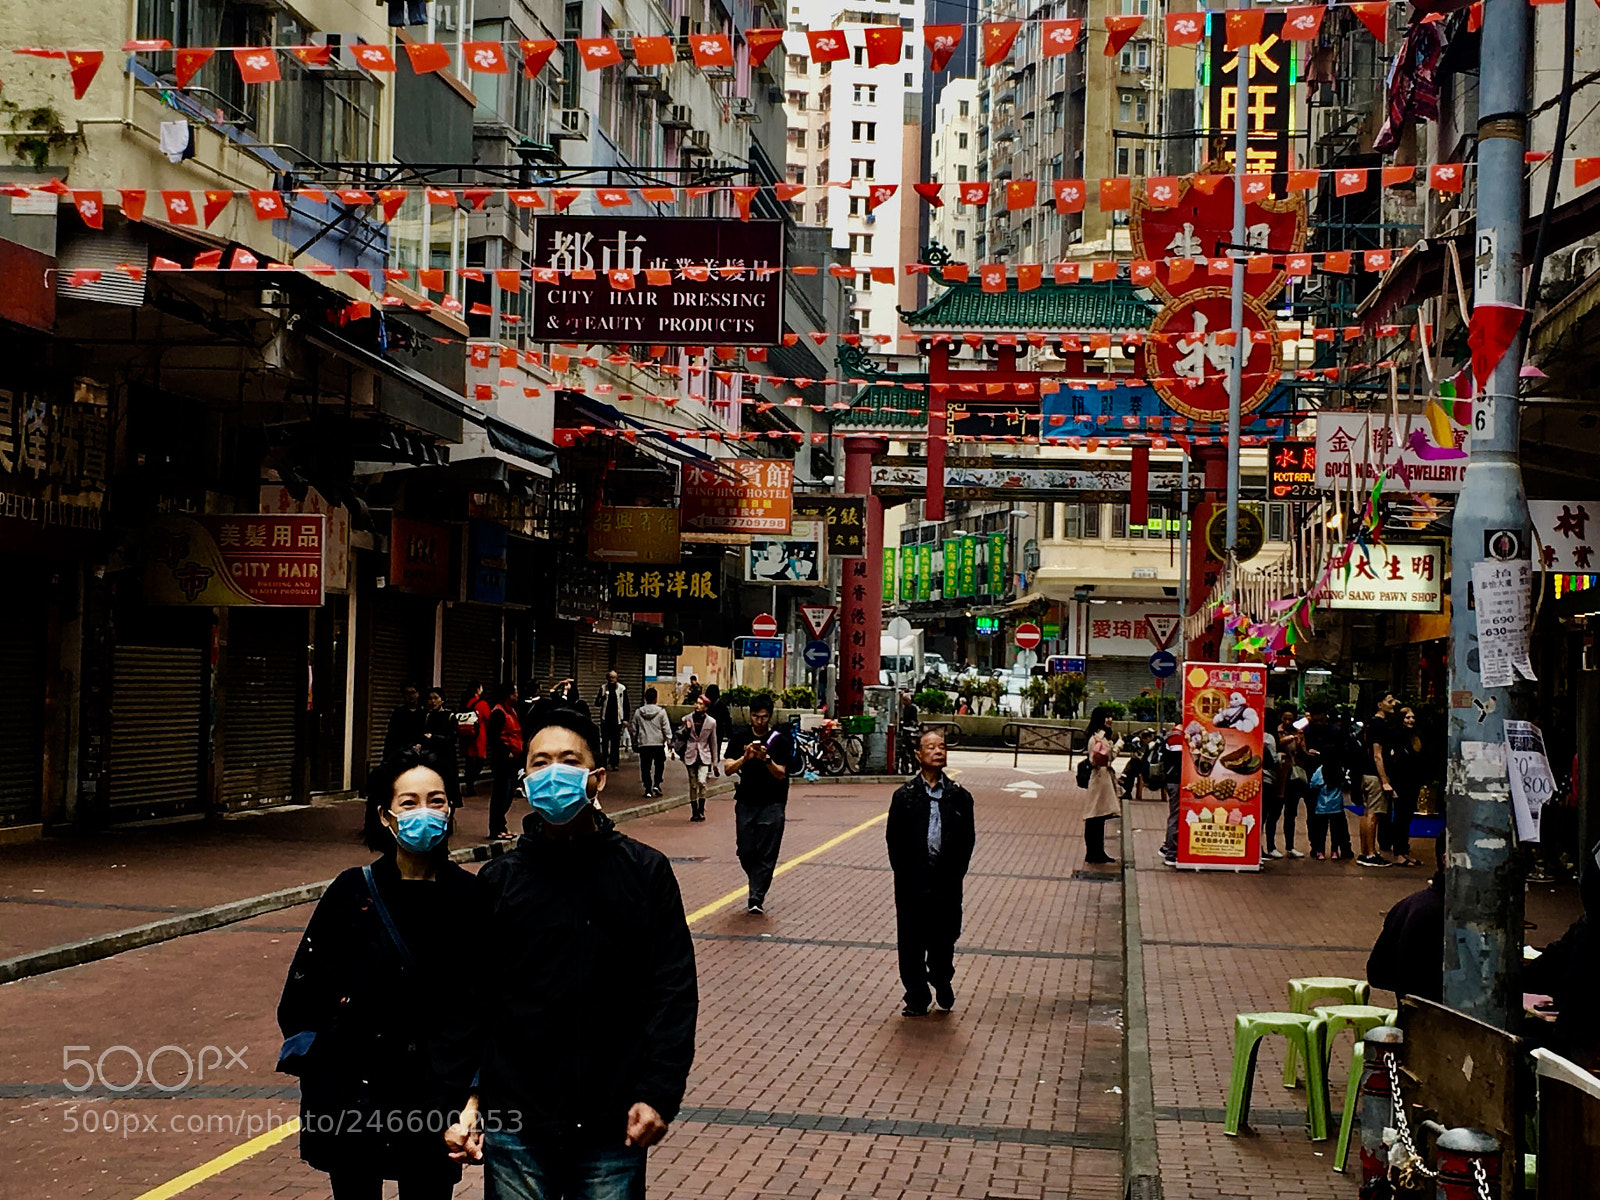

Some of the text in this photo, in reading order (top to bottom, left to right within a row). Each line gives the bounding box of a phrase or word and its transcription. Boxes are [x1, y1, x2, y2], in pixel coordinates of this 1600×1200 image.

[547, 290, 766, 308] CITY HAIR DRESSING
[547, 315, 559, 329] &
[659, 317, 755, 333] PRODUCTS
[686, 487, 789, 499] WING HING HOSTEL
[219, 524, 319, 548] 美髮用品
[231, 562, 318, 578] CITY HAIR
[613, 570, 718, 599] 龍將洋服
[1348, 591, 1375, 601] SANG
[1379, 592, 1407, 602] PAWN
[1411, 592, 1438, 603] SHOP
